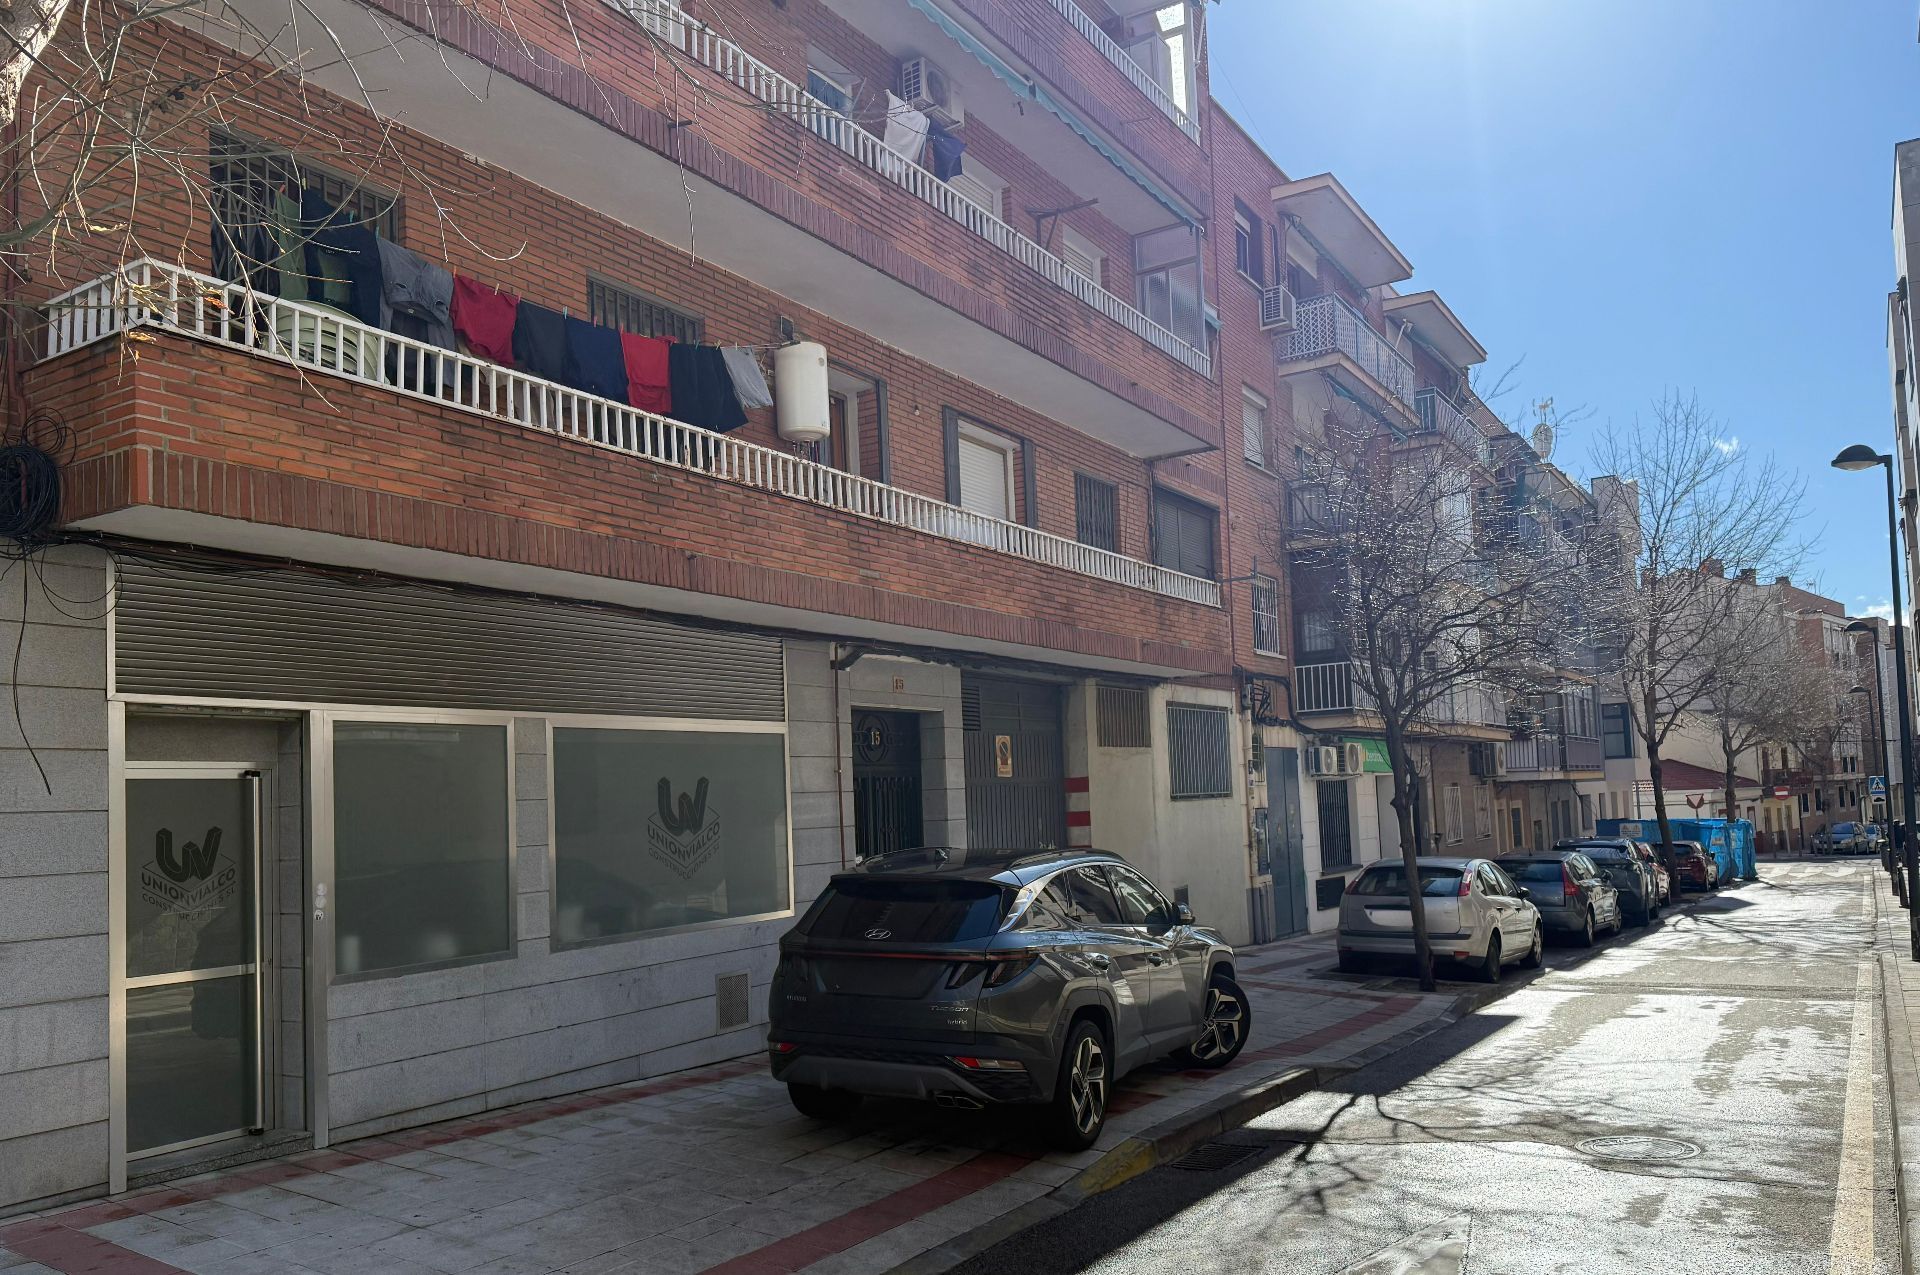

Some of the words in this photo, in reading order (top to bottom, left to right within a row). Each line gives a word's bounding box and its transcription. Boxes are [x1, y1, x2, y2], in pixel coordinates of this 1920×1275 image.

[871, 731, 881, 746] 15
[647, 821, 721, 862] UNIONVIALCO
[141, 867, 236, 906] UNIONVIALCO
